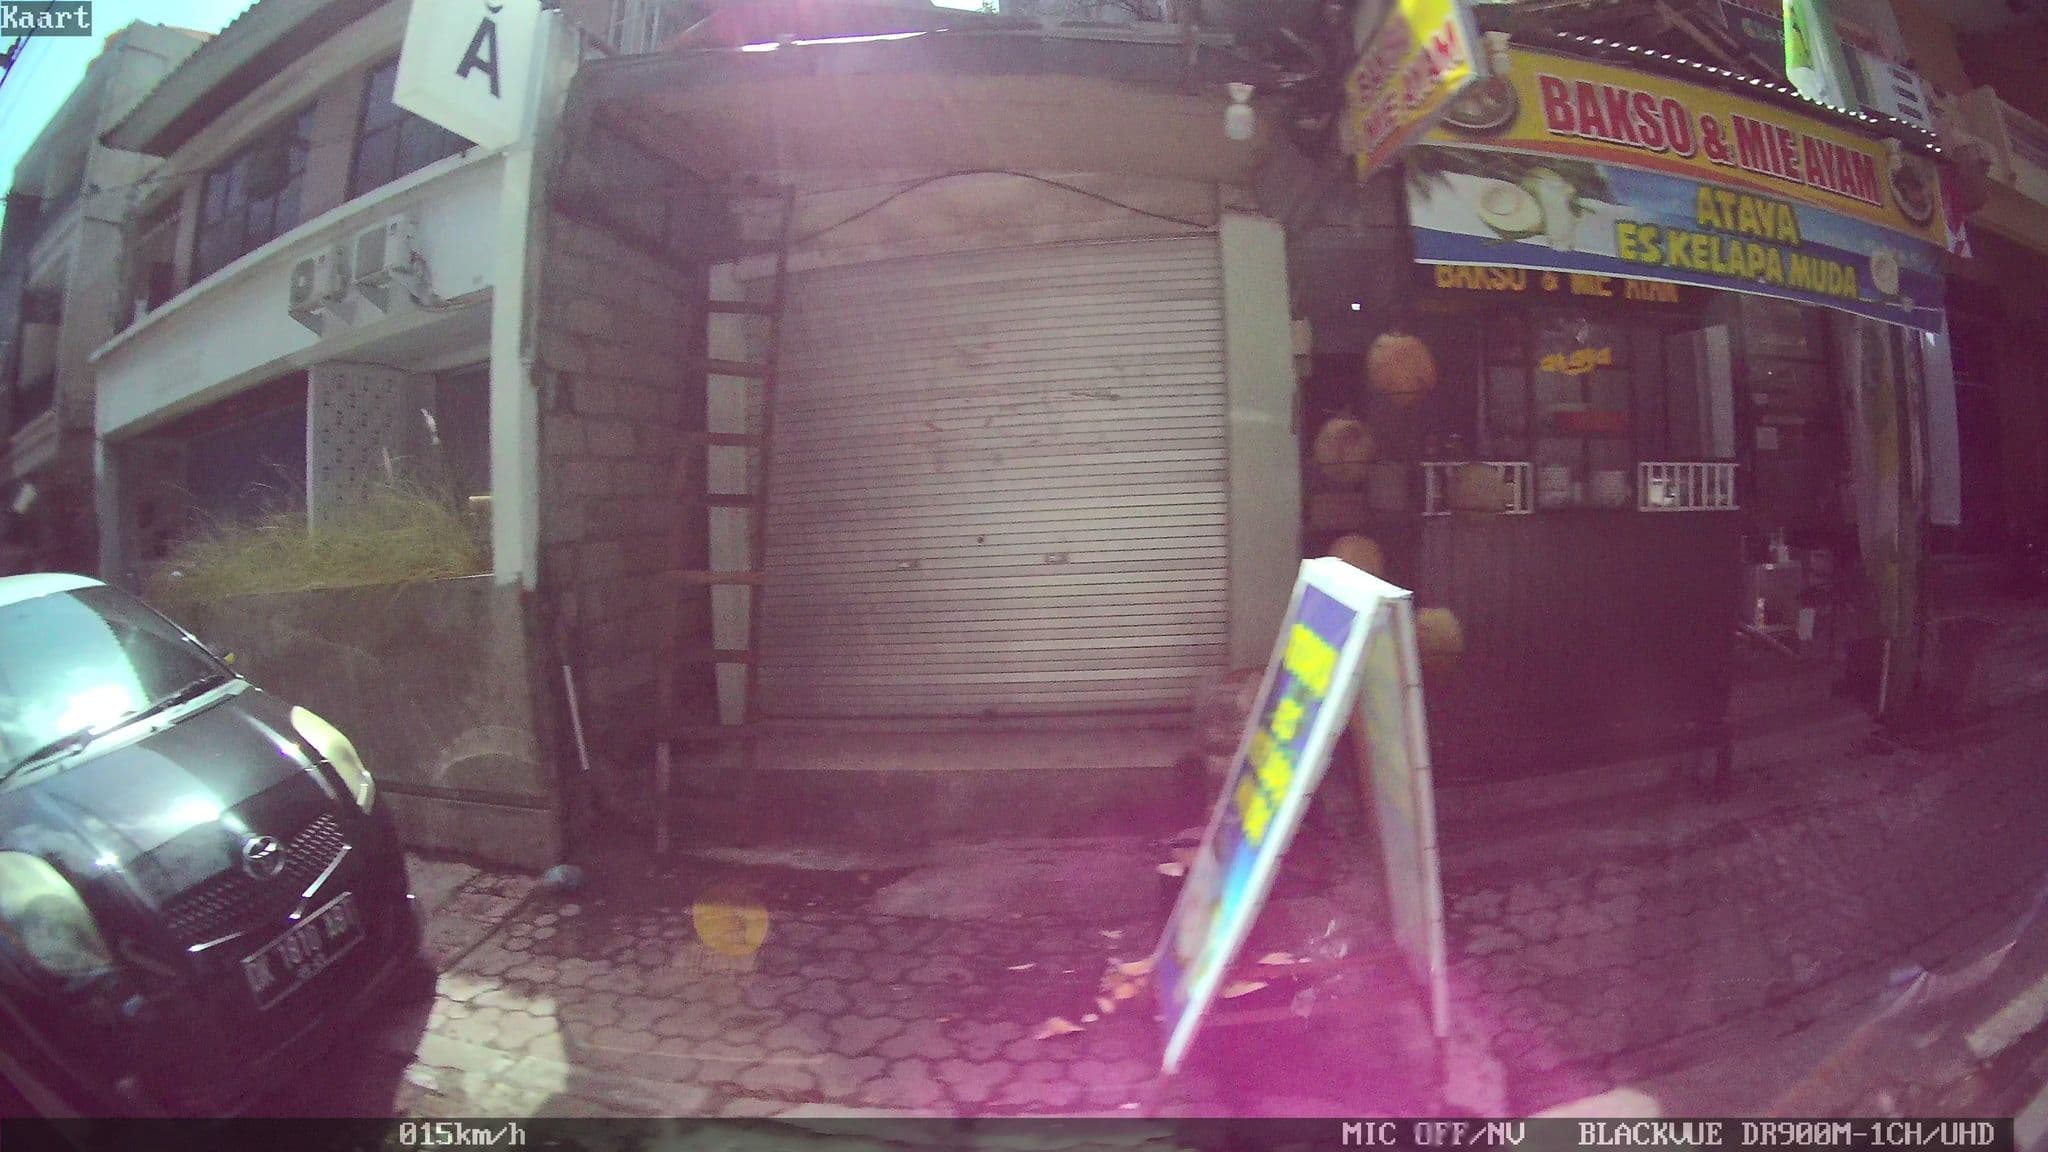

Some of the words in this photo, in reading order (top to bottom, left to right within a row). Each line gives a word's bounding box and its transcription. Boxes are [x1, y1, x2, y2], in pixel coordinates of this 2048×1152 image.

[1539, 74, 1697, 158] BAKSO
[1701, 115, 1735, 165] &
[1732, 115, 1800, 182] MIE
[1802, 135, 1882, 207] AYAM
[1616, 220, 1663, 265] ES
[1666, 229, 1785, 286] KELAPA
[1789, 252, 1859, 300] MUDA
